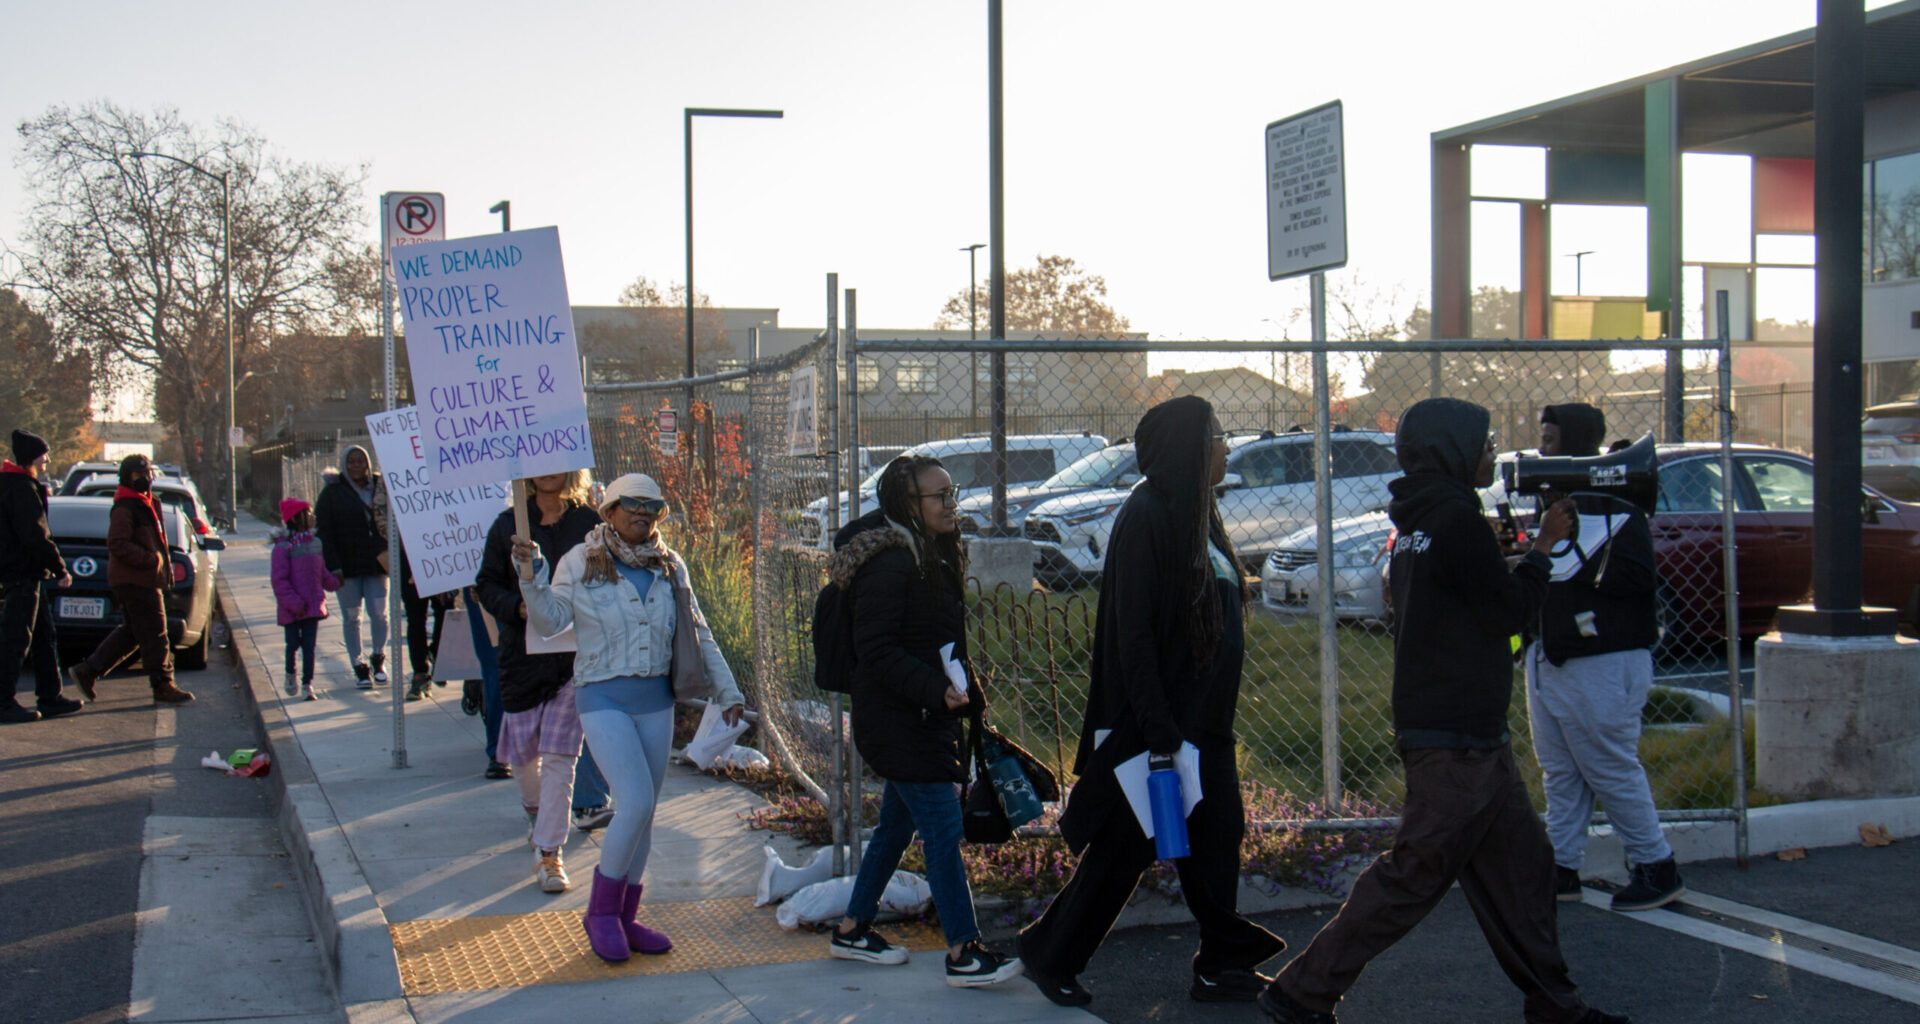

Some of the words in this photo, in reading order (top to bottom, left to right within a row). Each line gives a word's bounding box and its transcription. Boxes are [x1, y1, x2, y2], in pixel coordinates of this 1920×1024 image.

[400, 255, 432, 280] WE
[442, 245, 522, 274] DEMAND
[403, 284, 508, 321] PROPER
[434, 315, 565, 354] TRAINING
[476, 354, 500, 374] for
[430, 375, 528, 414] CULTURE
[538, 364, 555, 393] &
[369, 417, 394, 436] WE
[435, 405, 539, 441] CLIMATE
[439, 425, 586, 473] AMBASSADORS!
[422, 522, 487, 550] SCHOOL
[444, 511, 460, 527] IN
[421, 548, 484, 579] DISCIP
